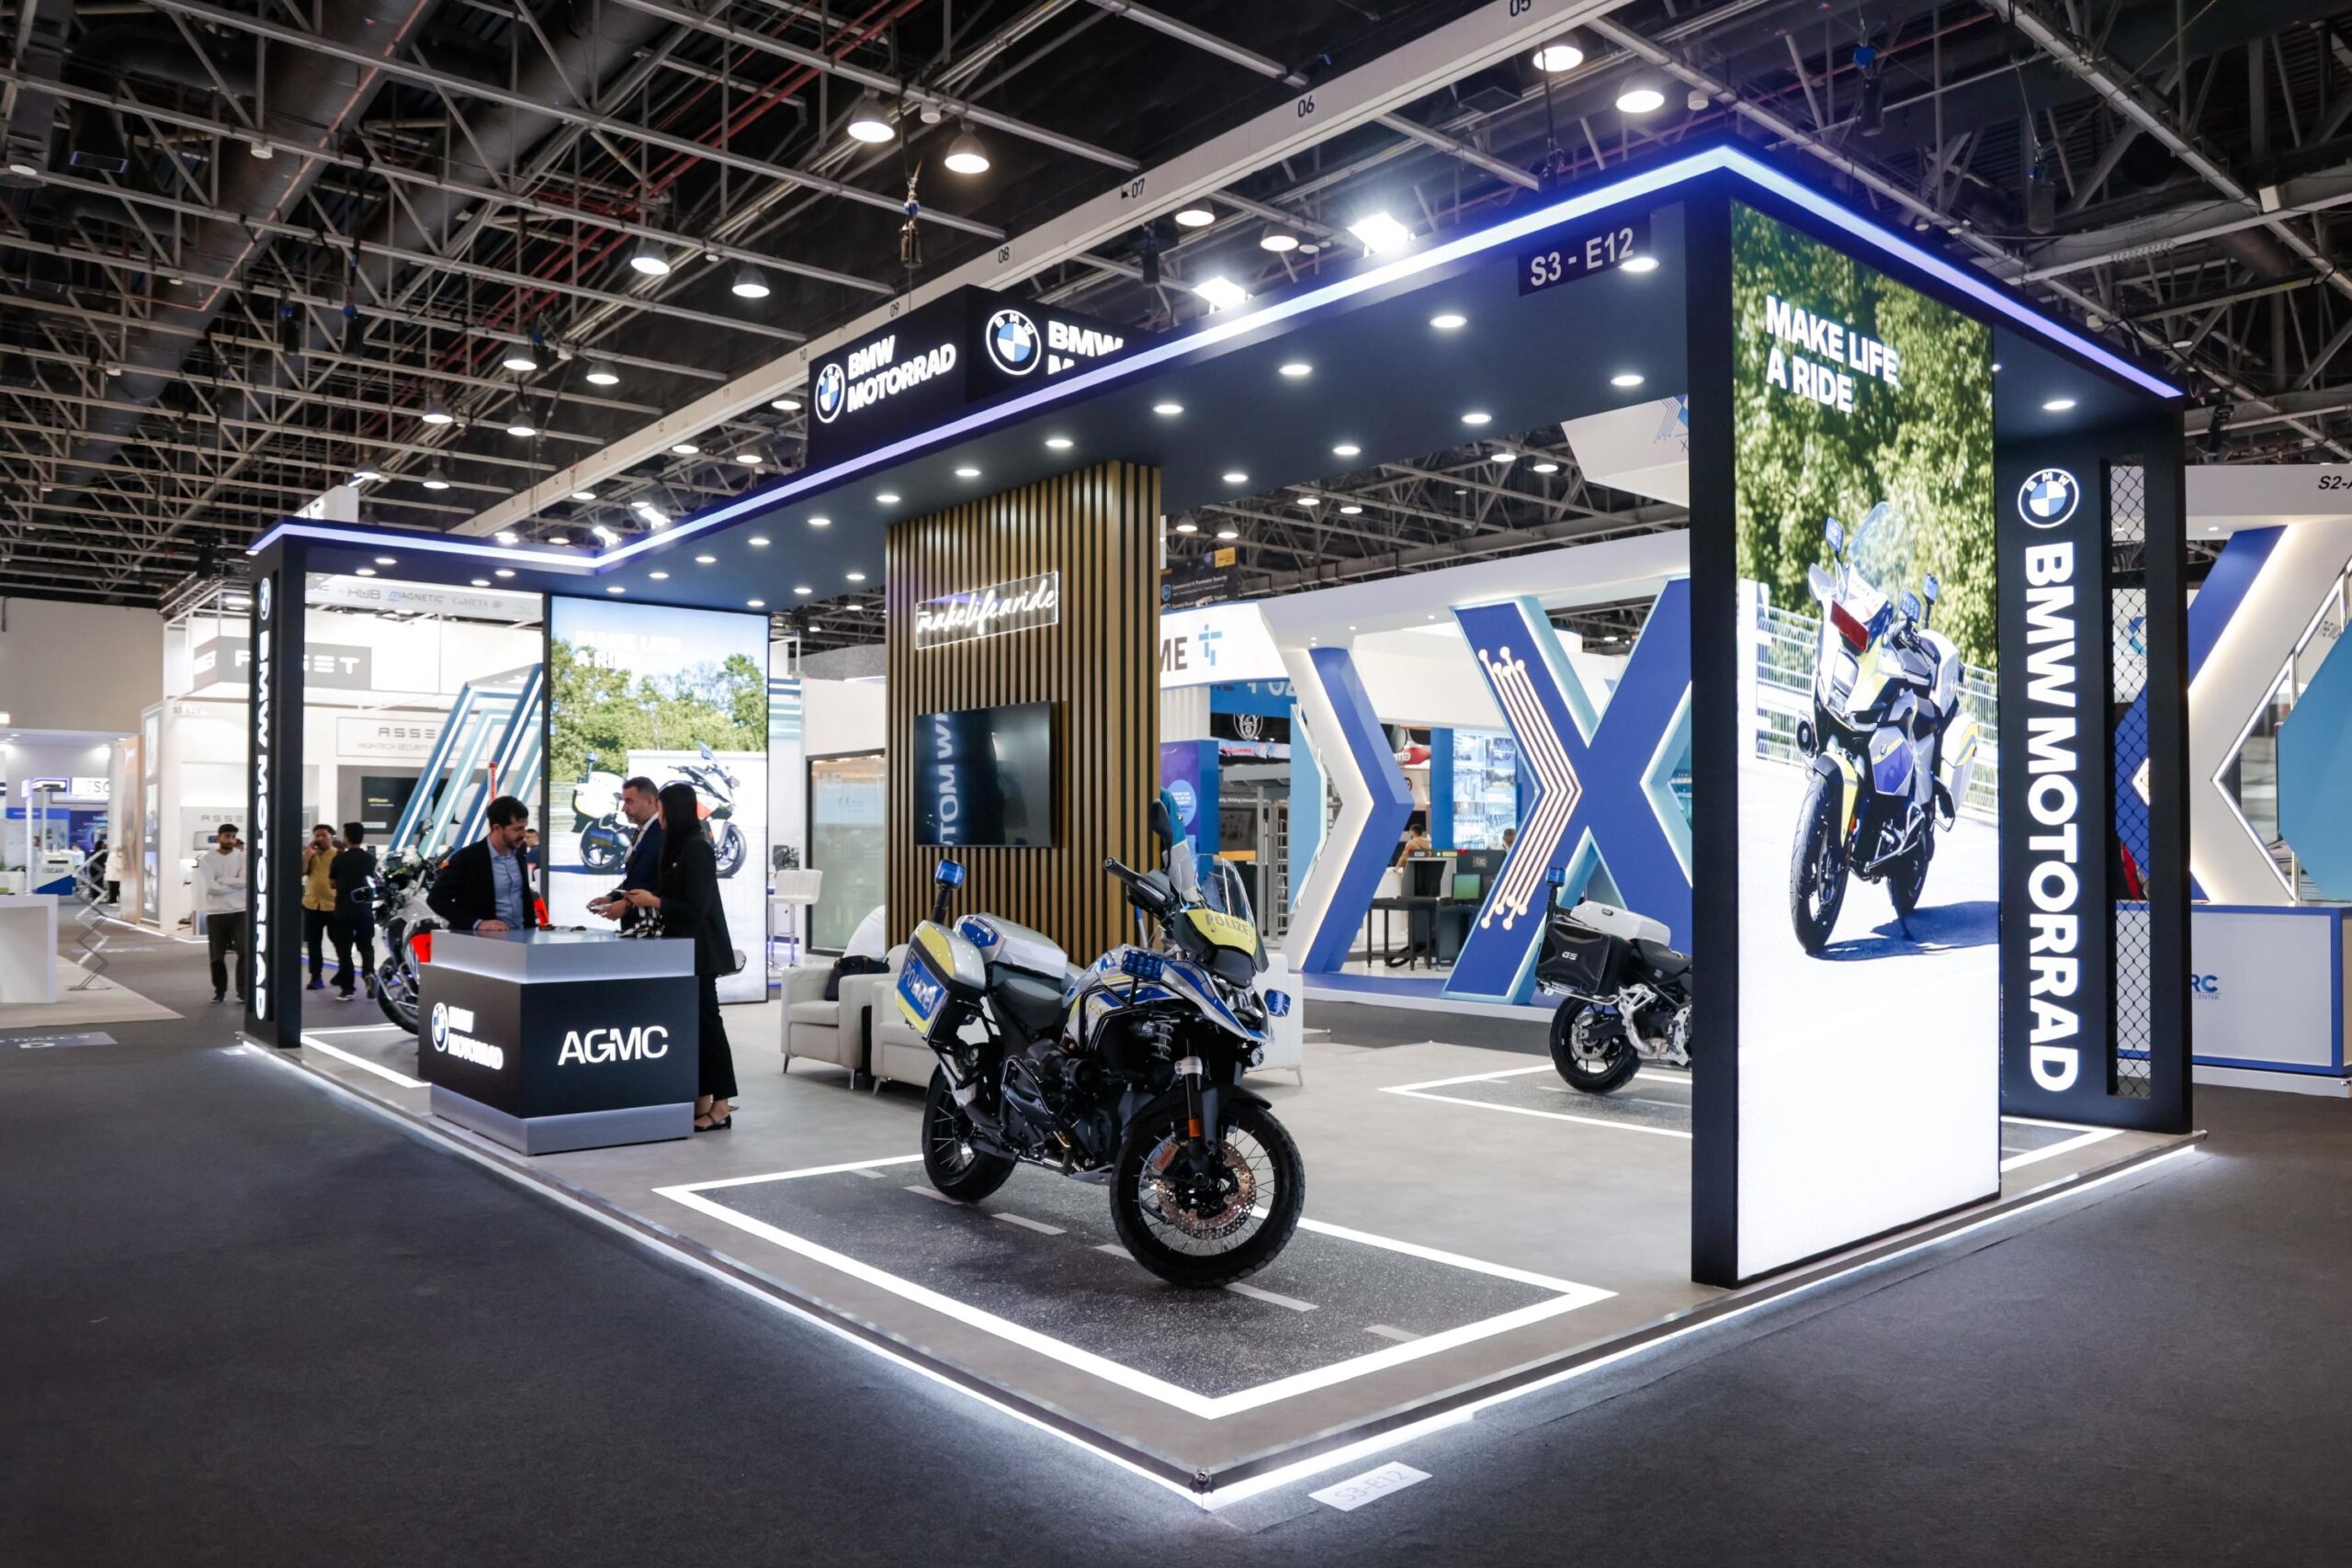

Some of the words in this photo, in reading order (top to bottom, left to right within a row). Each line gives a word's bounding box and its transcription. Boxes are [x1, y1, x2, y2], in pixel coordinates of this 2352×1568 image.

[1297, 96, 1316, 118] 06
[1131, 179, 1146, 198] 07
[998, 246, 1010, 264] 08
[1530, 251, 1562, 287] S3
[1586, 227, 1634, 270] E12
[890, 301, 900, 318] 09
[799, 347, 808, 361] 10
[1048, 320, 1124, 357] BMW
[1766, 294, 1844, 364] MAKE
[1849, 331, 1899, 387] LIFE
[848, 334, 896, 381] BMW
[847, 343, 956, 413] MOTORRAD
[1766, 346, 1787, 389] A
[1792, 355, 1853, 413] RIDE
[2025, 471, 2072, 492] BMW
[2025, 541, 2077, 708] BMW
[378, 727, 444, 739] ASSE
[2026, 717, 2079, 1093] MOTORRAD
[1205, 913, 1251, 938] POLIZE
[1562, 951, 1577, 961] GS
[557, 1025, 669, 1066] AGMC
